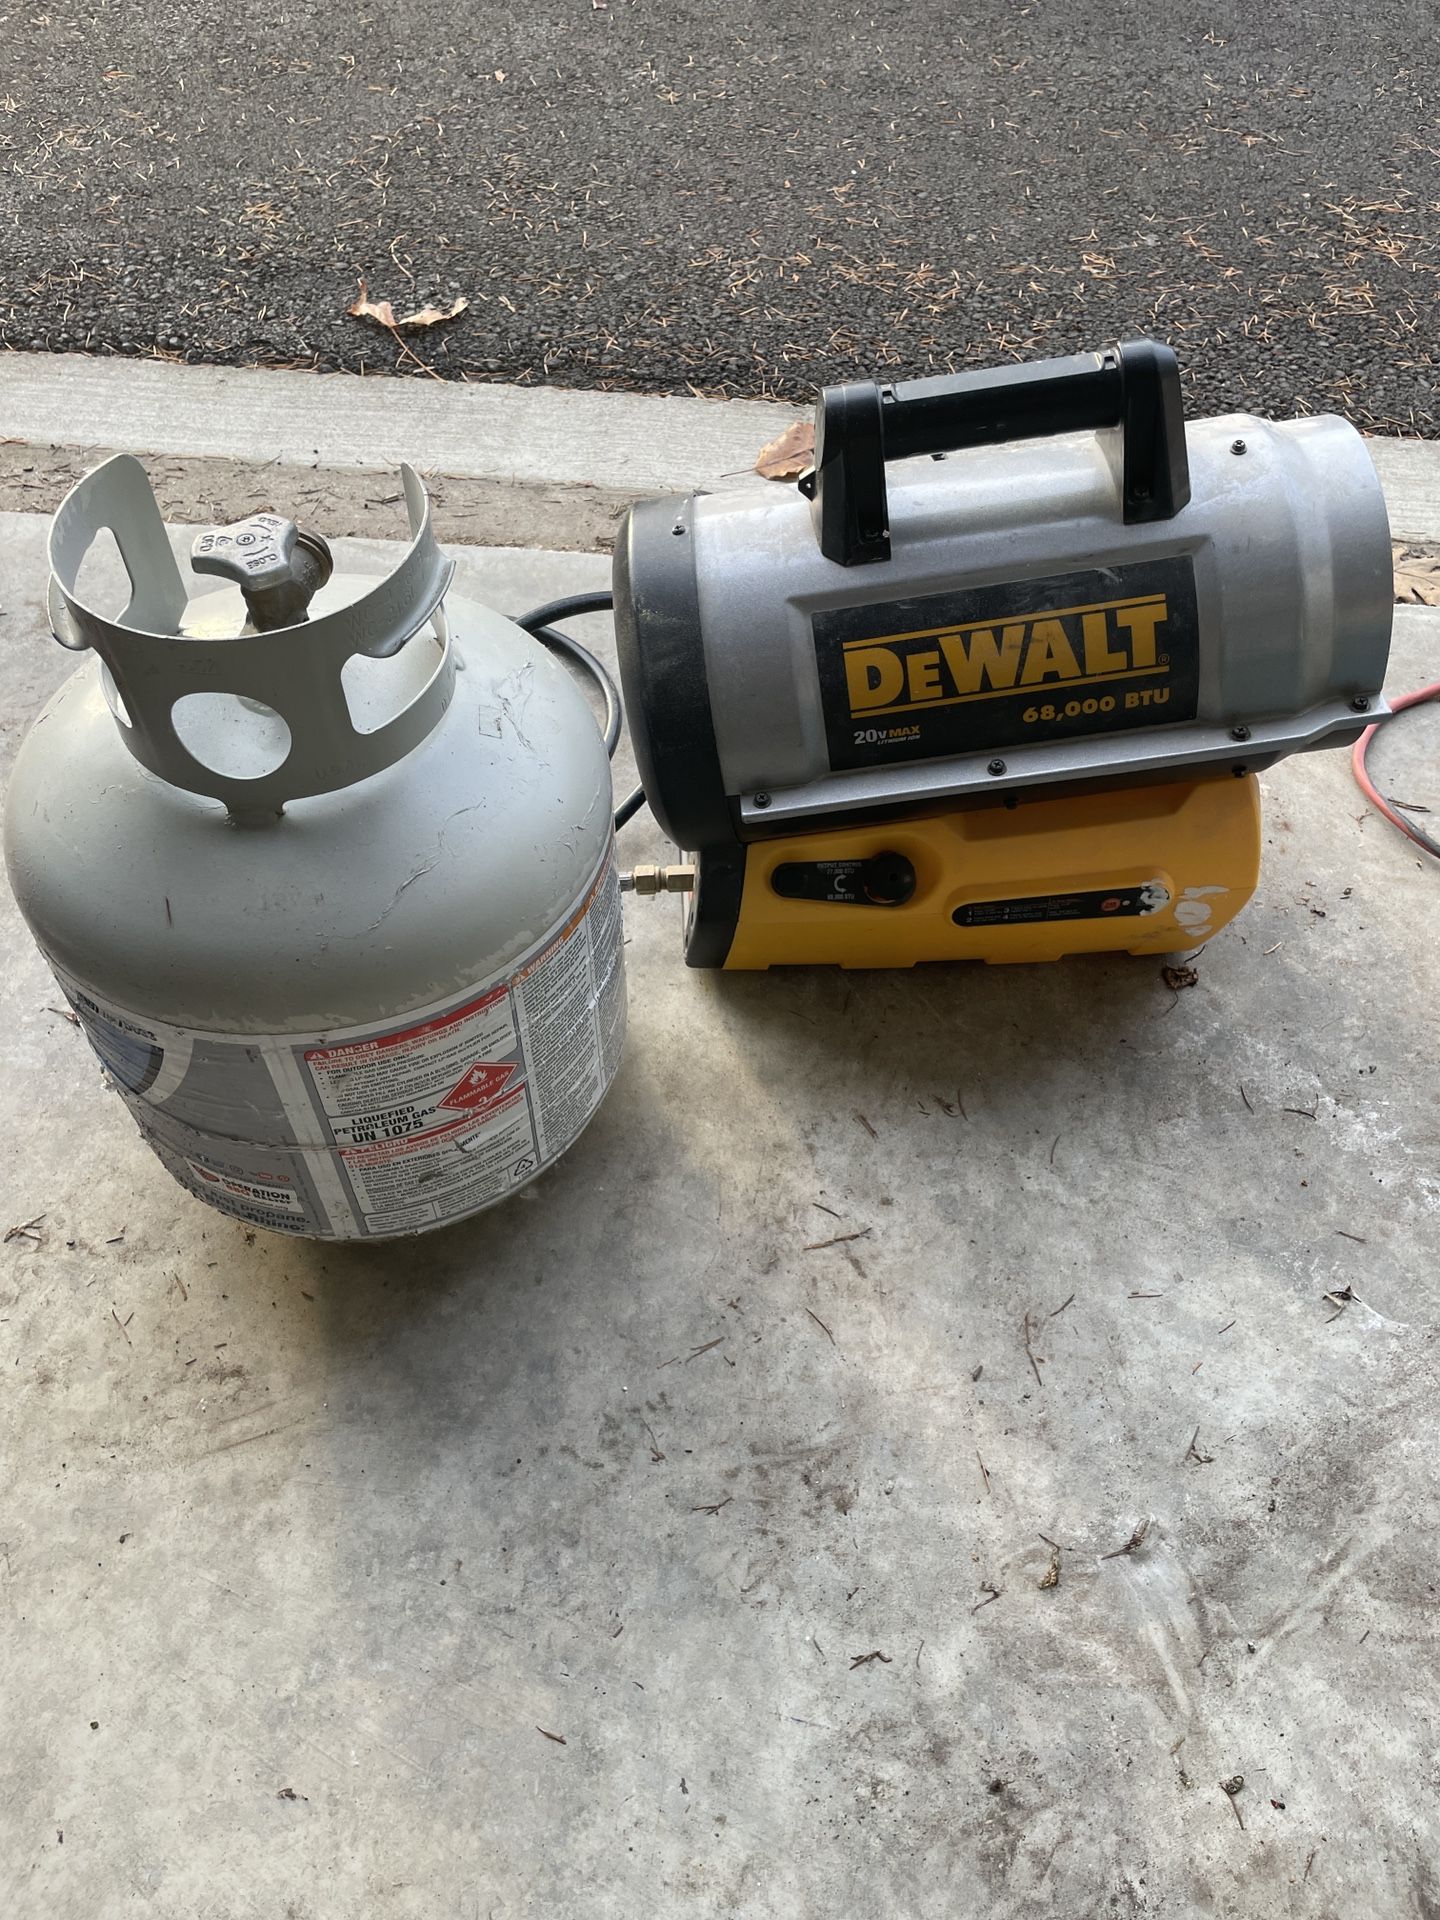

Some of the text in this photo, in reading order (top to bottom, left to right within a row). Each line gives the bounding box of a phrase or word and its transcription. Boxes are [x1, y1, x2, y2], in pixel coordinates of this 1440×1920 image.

[246, 553, 278, 569] CLOSE
[1022, 686, 1171, 723] 68,000 BTU
[889, 724, 921, 738] MAX
[526, 935, 565, 974] WARNING
[327, 1042, 379, 1058] DANGER
[355, 1051, 373, 1059] OBEY
[411, 1027, 447, 1045] WARNINGS
[449, 1020, 462, 1030] AND
[331, 1060, 357, 1069] RESULT
[402, 1041, 425, 1053] INJURY
[343, 1061, 376, 1073] OUTDOOR
[449, 1081, 493, 1106] FLAMMABLE
[495, 1071, 510, 1082] GAS
[333, 1115, 409, 1136] PETROLEUM
[412, 1106, 437, 1120] GAS
[351, 1106, 415, 1126] LIQUEFIED
[351, 1118, 424, 1143] UN 1075
[402, 1147, 440, 1167] EXTERIORES
[222, 1178, 291, 1200] OPERATION
